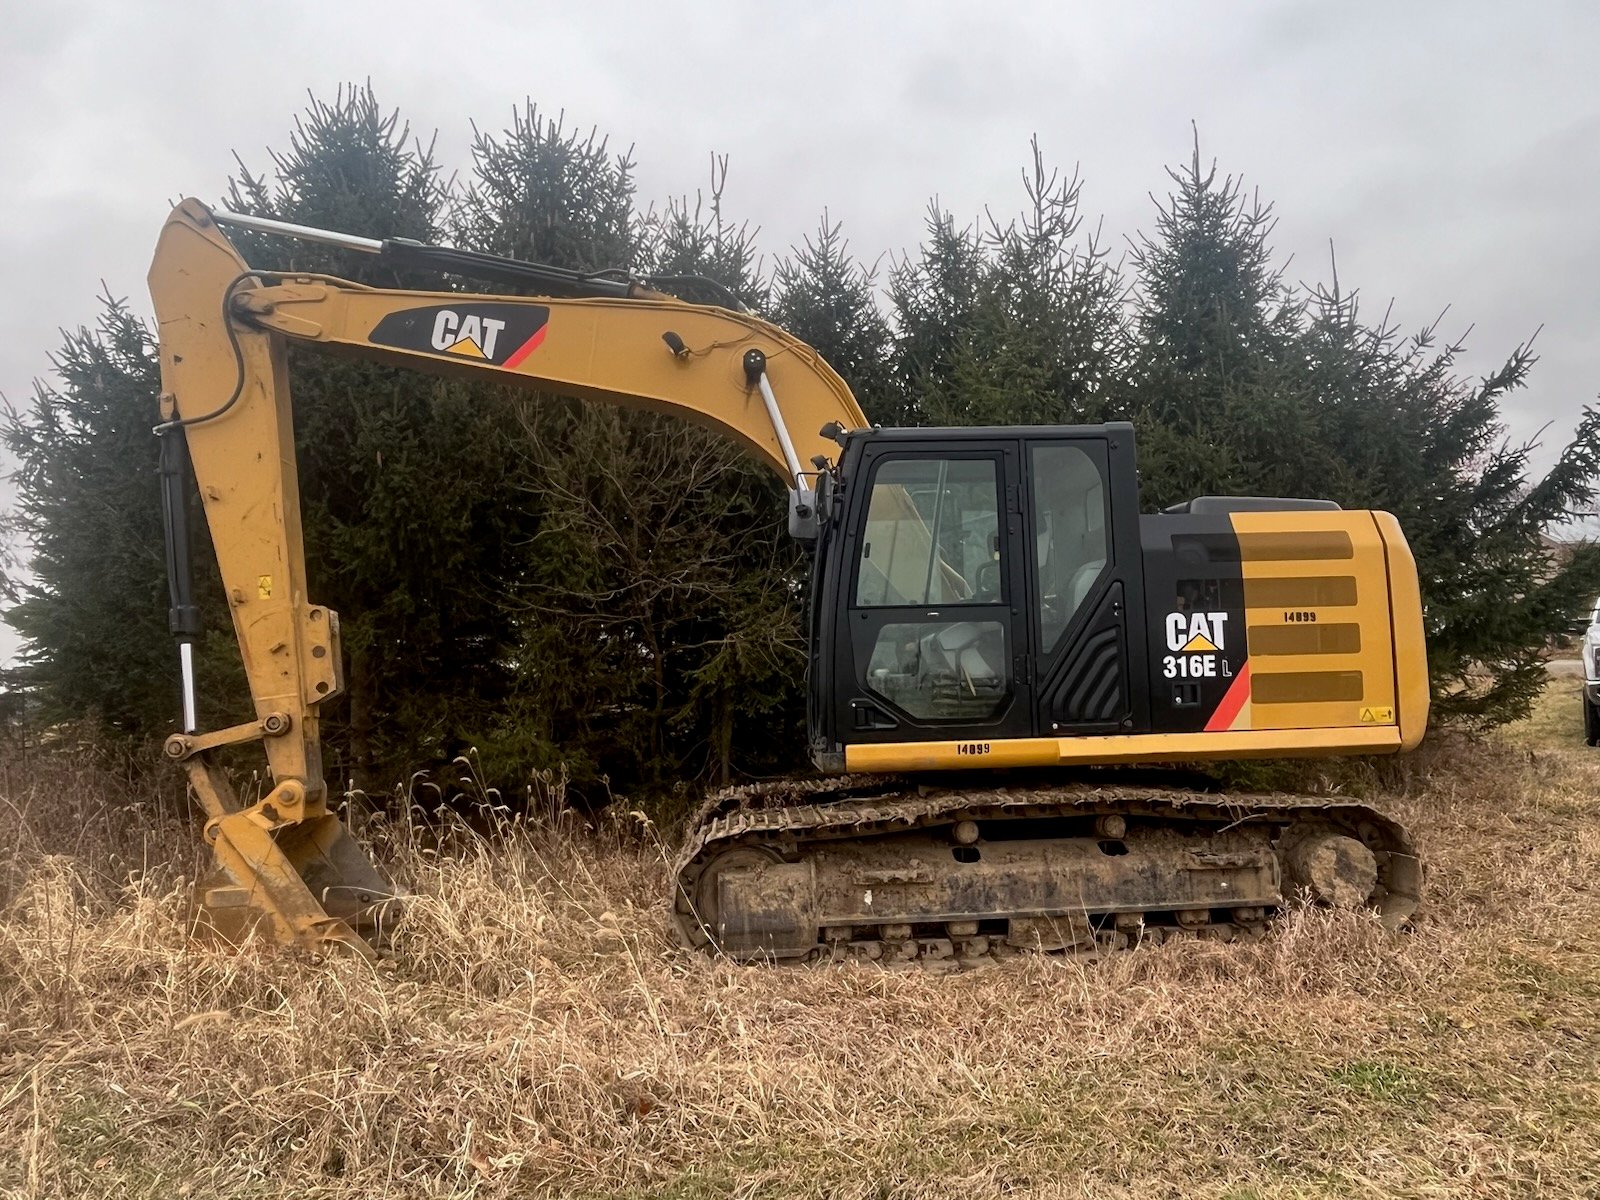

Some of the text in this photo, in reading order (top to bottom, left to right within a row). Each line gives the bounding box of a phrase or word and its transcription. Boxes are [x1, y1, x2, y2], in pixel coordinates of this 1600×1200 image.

[431, 310, 506, 360] CAT
[1165, 612, 1228, 652] CAT
[1162, 655, 1217, 678] 316E
